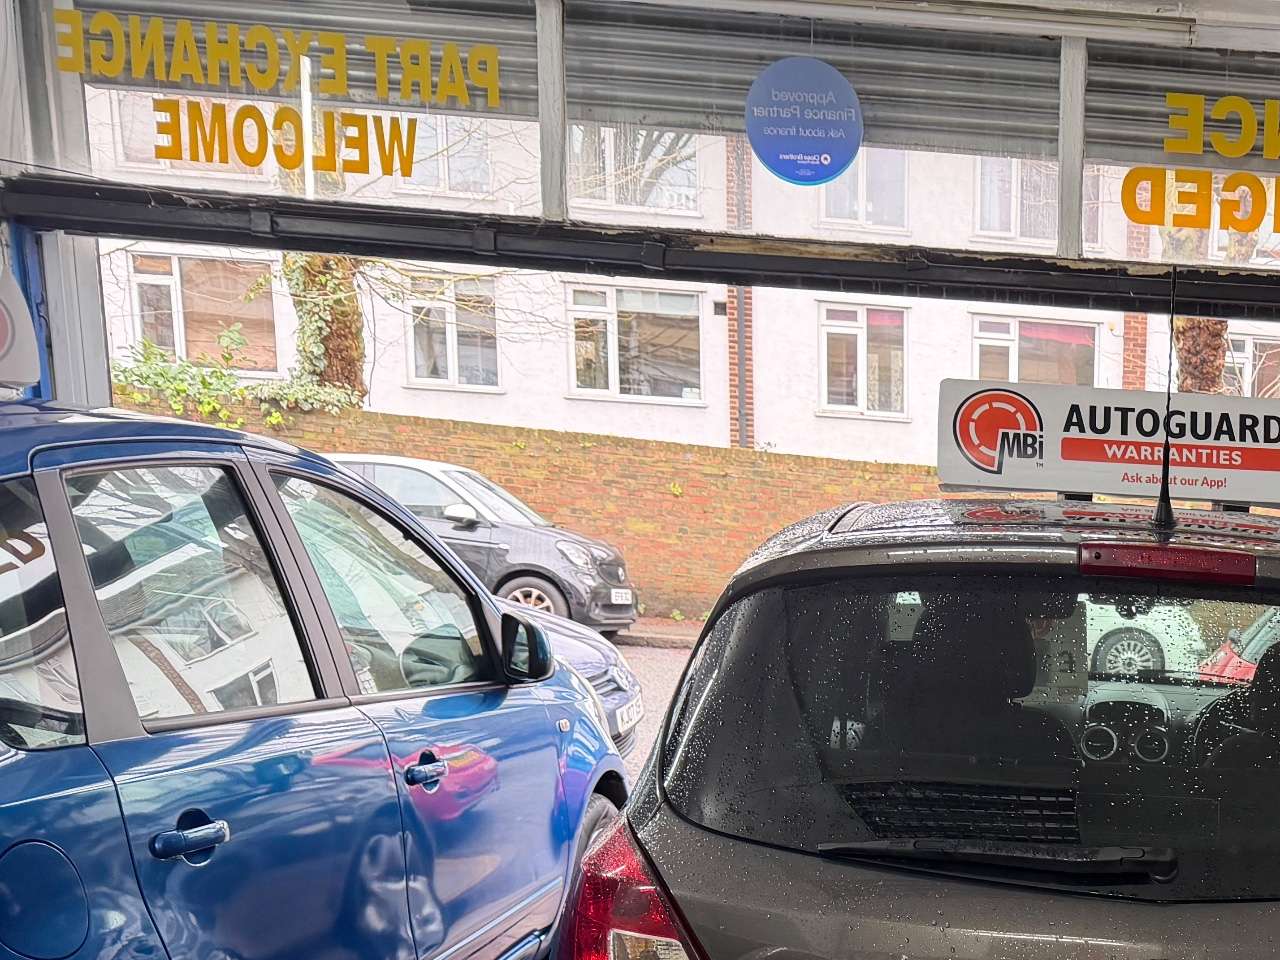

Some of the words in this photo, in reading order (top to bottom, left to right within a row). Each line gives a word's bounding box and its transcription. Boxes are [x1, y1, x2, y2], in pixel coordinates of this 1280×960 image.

[1000, 431, 1044, 460] MBi
[1103, 443, 1243, 466] WARRANTIES
[1121, 472, 1143, 483] Ask
[1180, 477, 1200, 486] our
[1201, 476, 1227, 489] App!
